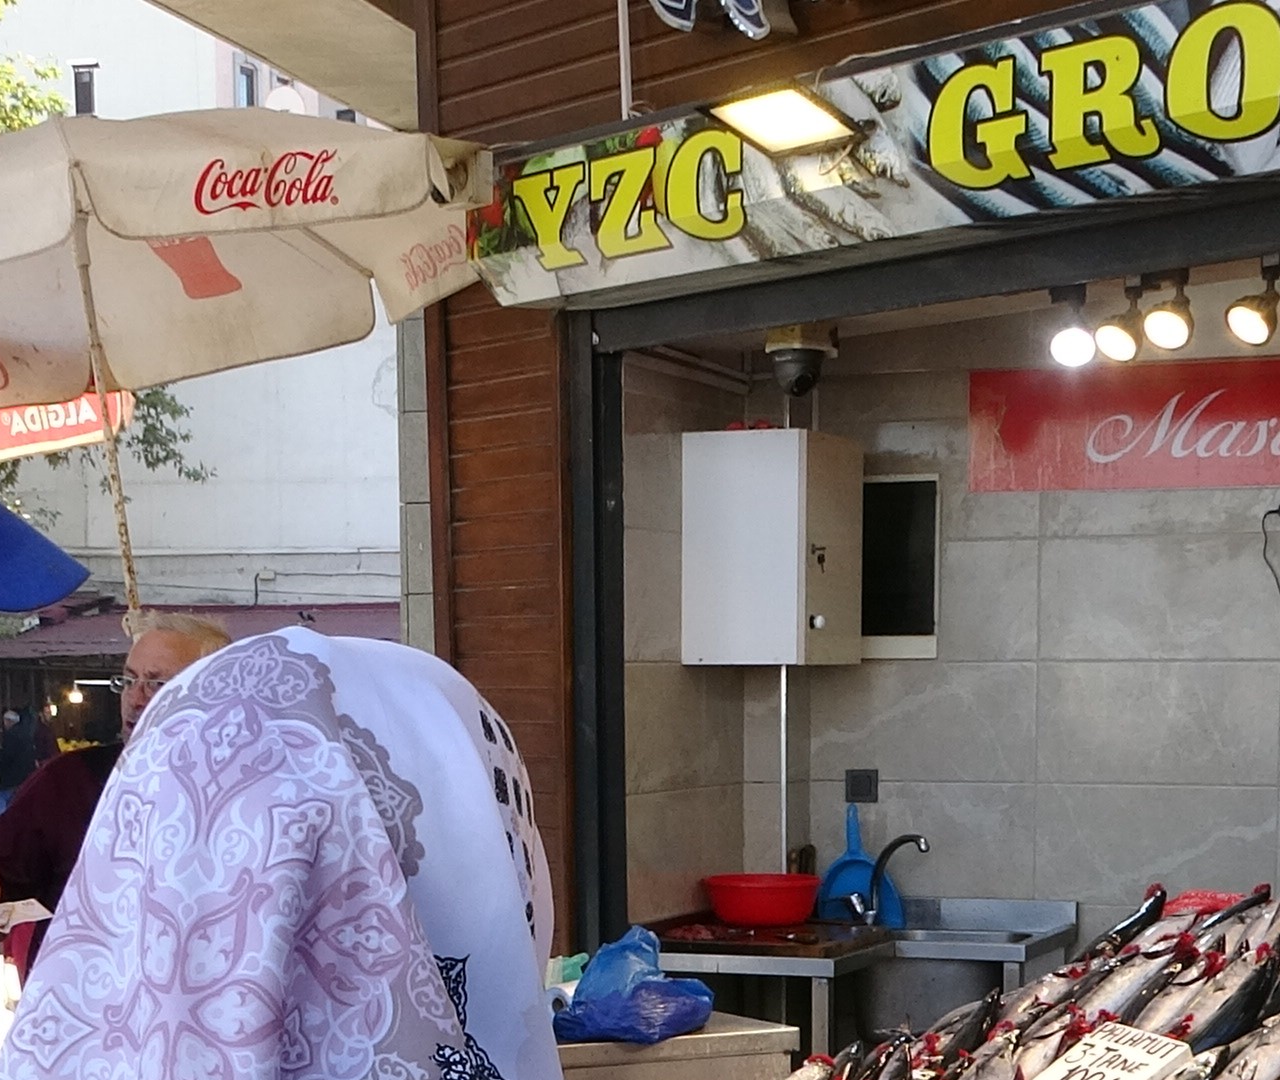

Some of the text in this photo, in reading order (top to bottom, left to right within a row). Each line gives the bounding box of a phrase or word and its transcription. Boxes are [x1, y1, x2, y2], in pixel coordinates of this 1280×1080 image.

[194, 149, 338, 215] Coca-Cola
[513, 129, 747, 271] YZC
[1089, 1023, 1185, 1059] PALAMUT
